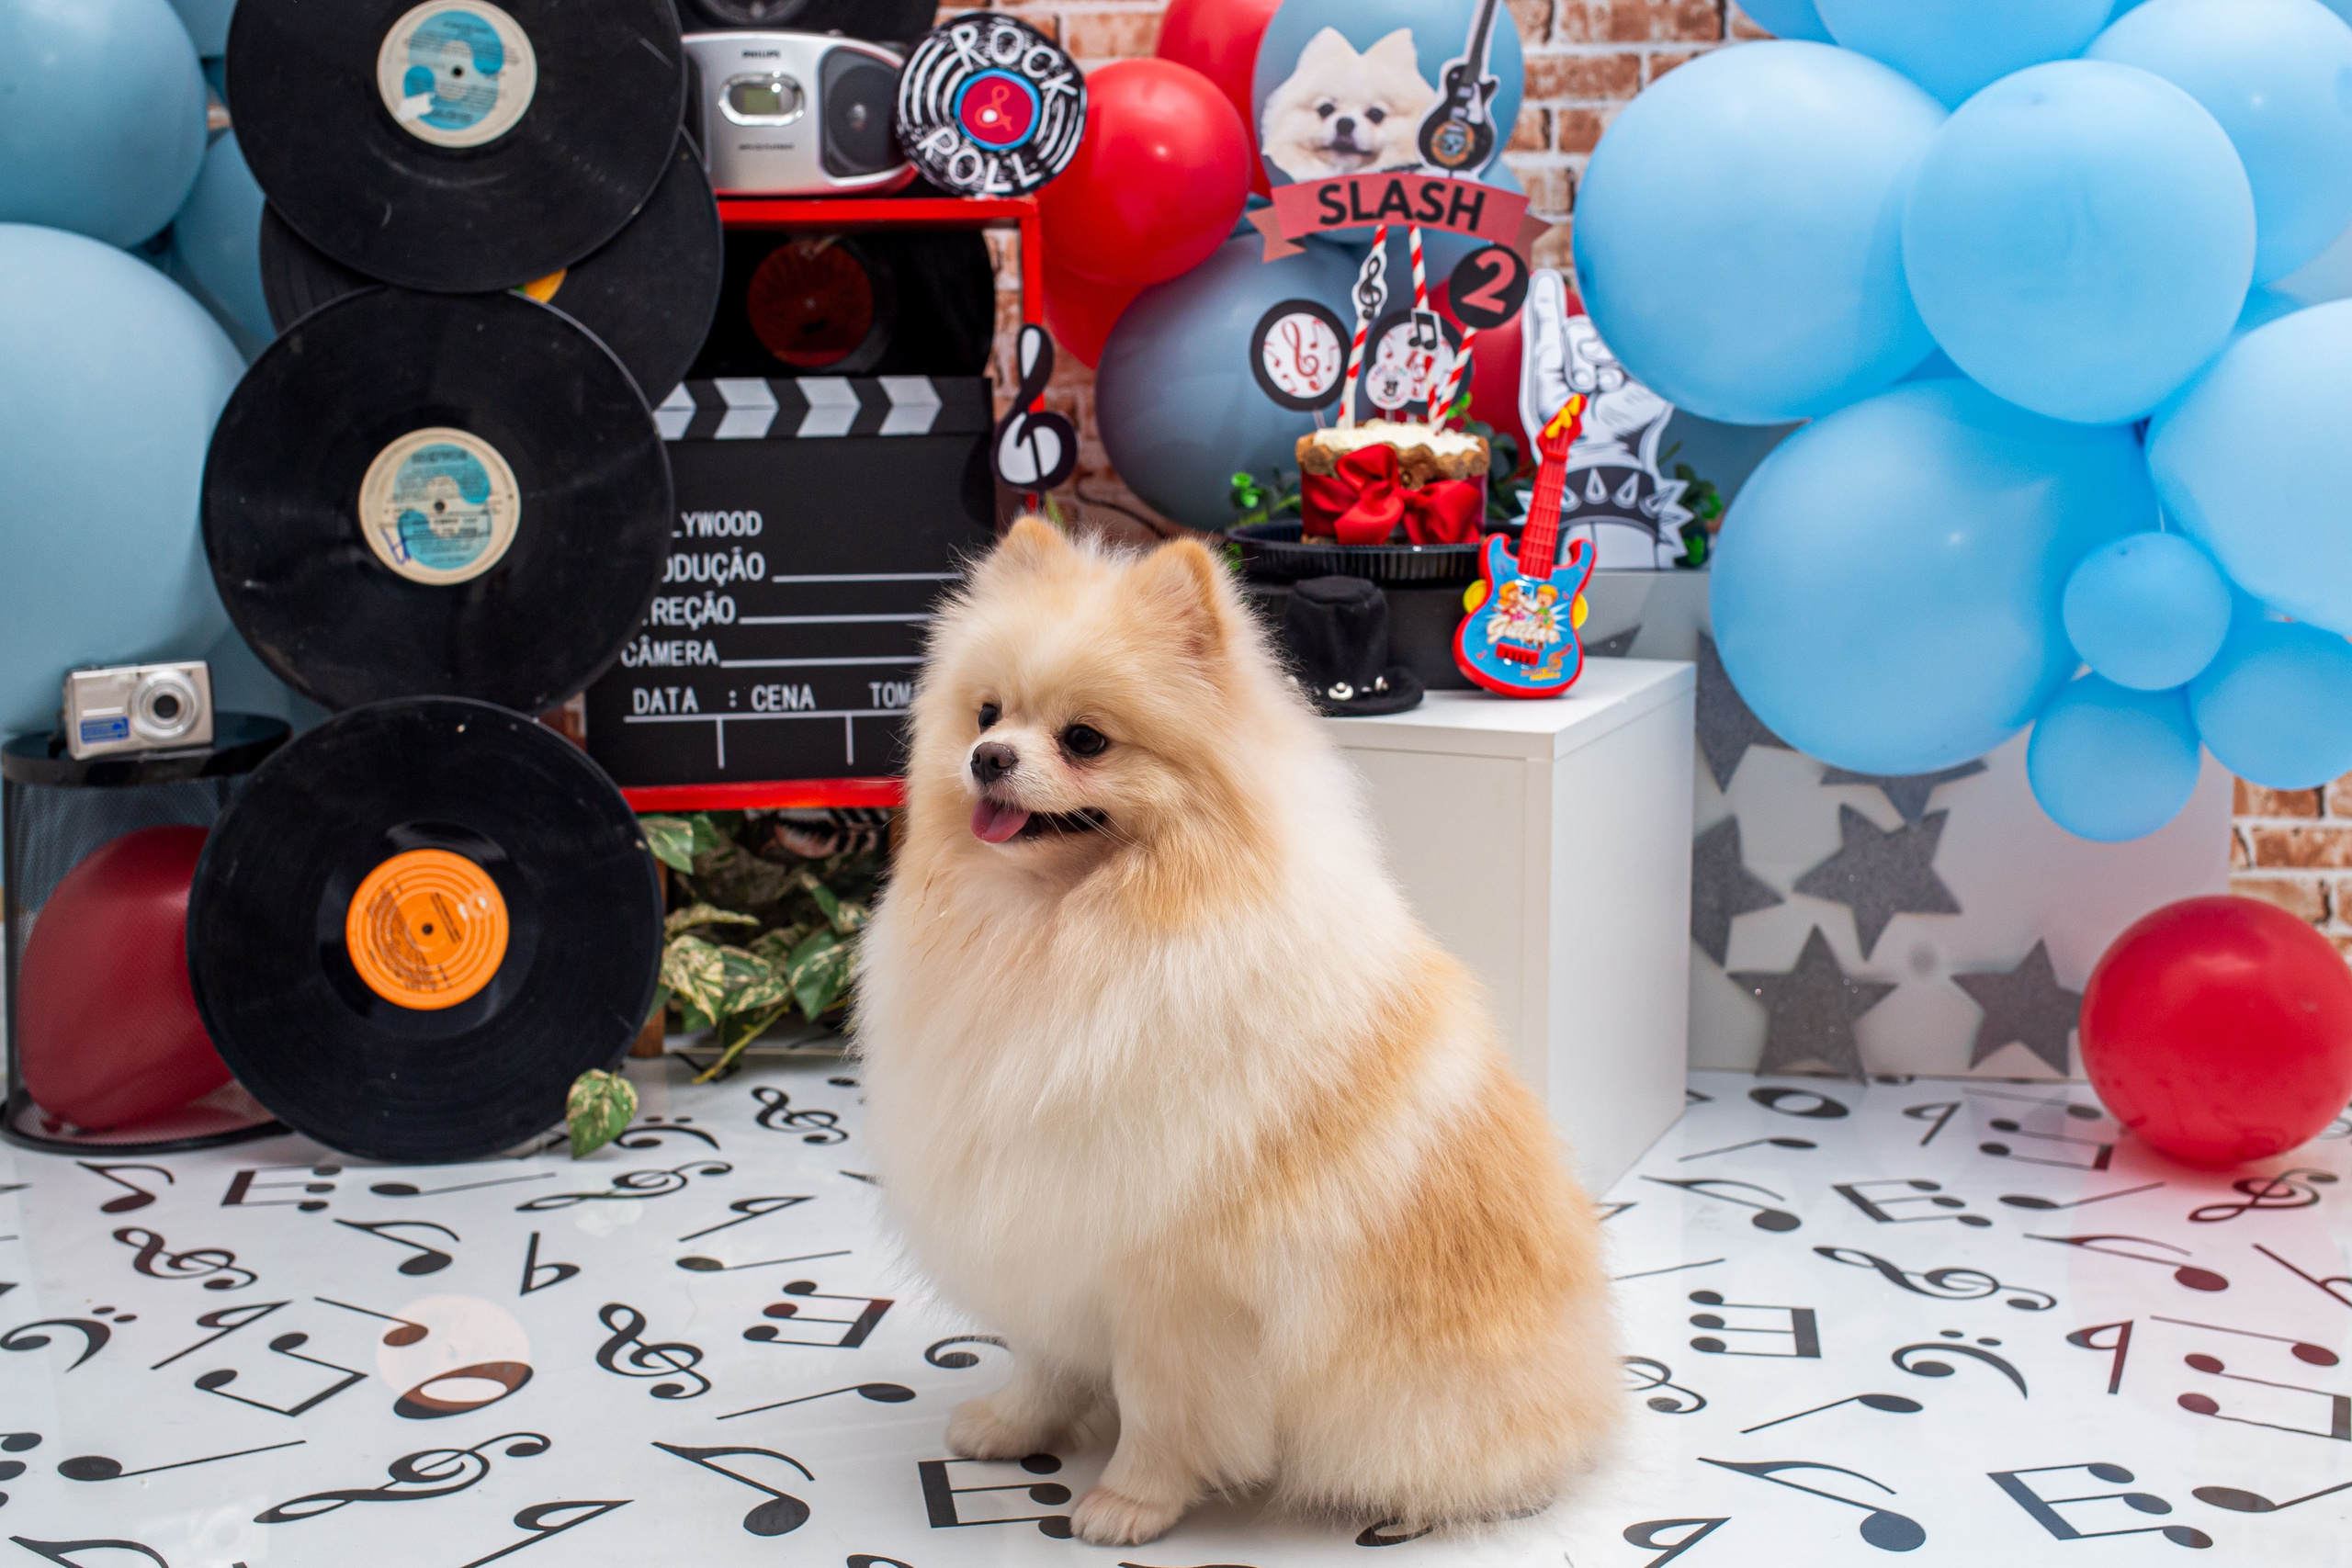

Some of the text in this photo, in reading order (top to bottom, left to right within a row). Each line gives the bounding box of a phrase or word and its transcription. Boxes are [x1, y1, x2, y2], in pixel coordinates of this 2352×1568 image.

[950, 24, 1078, 104] ROCK
[917, 127, 1042, 193] ROLL
[1317, 178, 1486, 231] SLASH
[1461, 249, 1516, 314] 2
[672, 510, 763, 537] YWOOD
[641, 590, 736, 631] REÇÃO
[620, 634, 718, 668] CÂMERA
[632, 685, 699, 715] DATA
[751, 682, 816, 712] CENA
